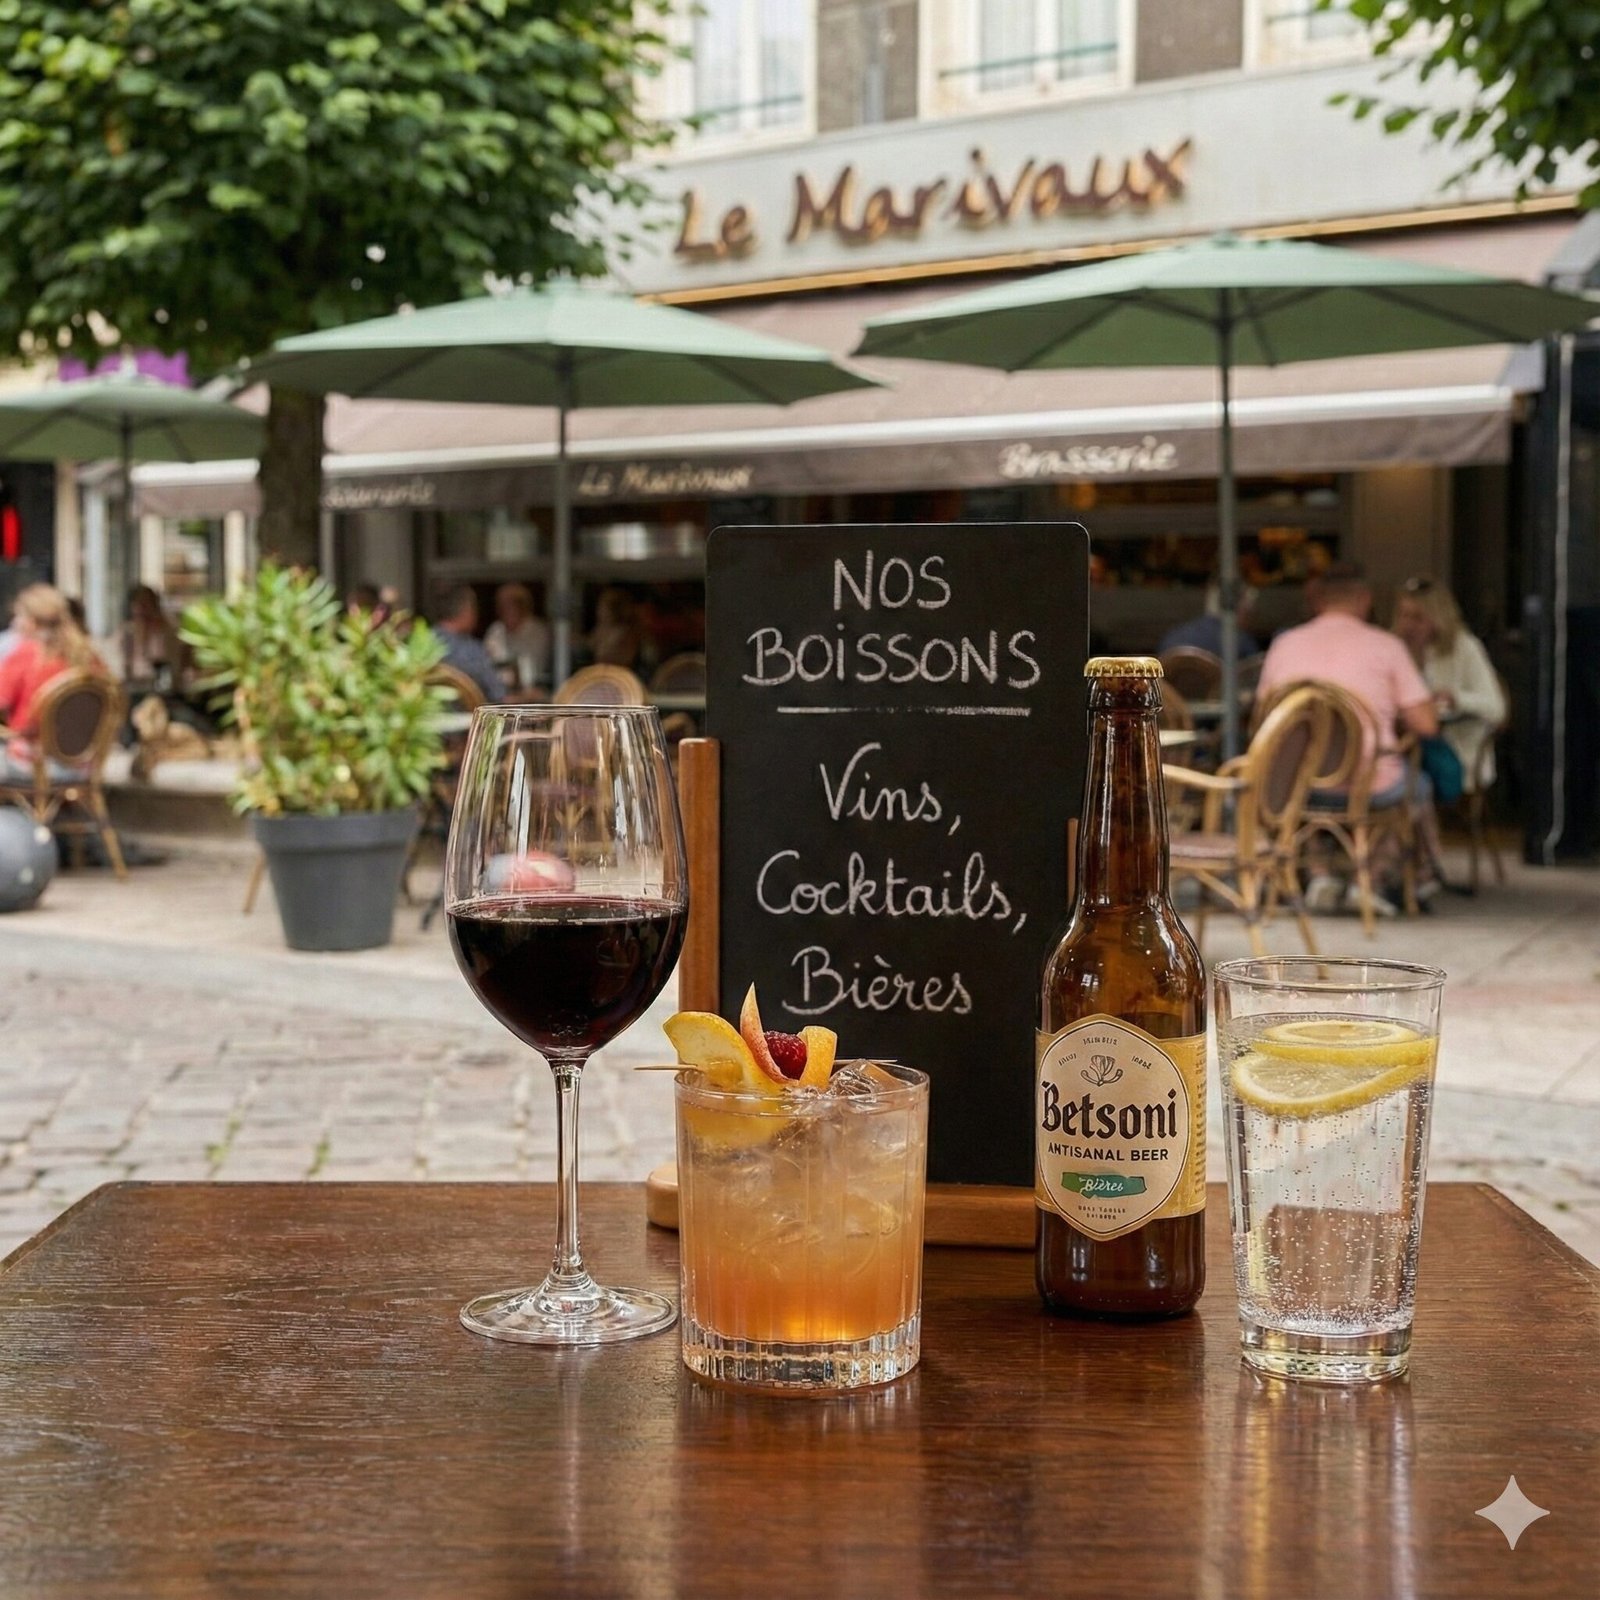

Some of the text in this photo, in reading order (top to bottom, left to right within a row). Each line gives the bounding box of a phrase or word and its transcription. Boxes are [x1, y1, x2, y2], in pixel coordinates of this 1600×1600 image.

[674, 139, 1193, 257] Le Marivaux
[833, 549, 952, 611] NOS
[819, 741, 962, 836] Vins,
[756, 849, 1028, 935] Cocktails,
[781, 945, 973, 1016] Bières
[1041, 1080, 1178, 1140] Betsoni
[1130, 1148, 1169, 1162] BEER
